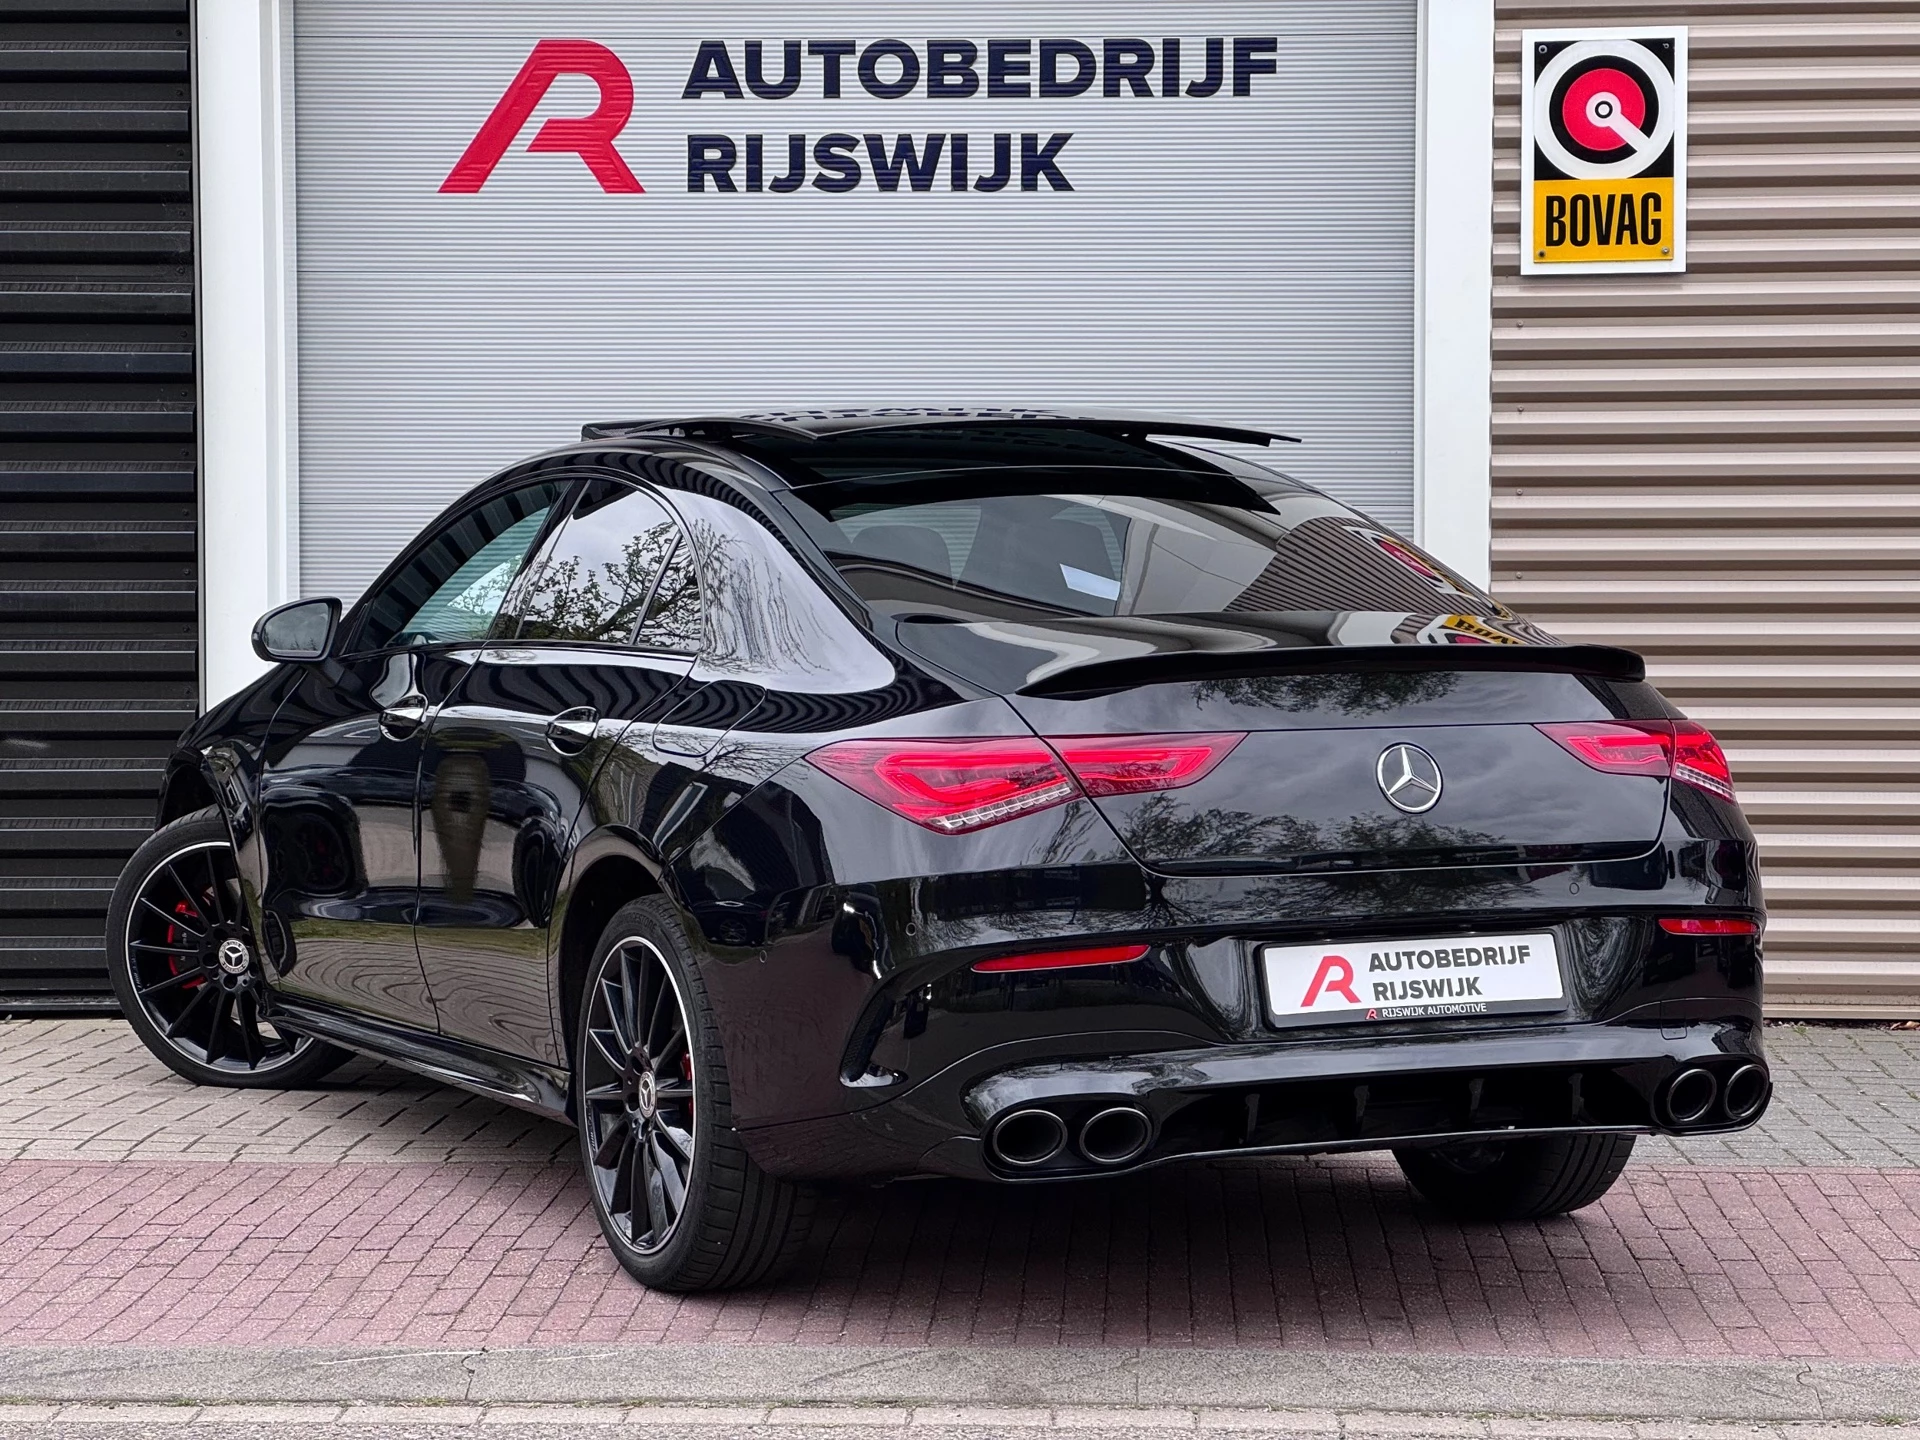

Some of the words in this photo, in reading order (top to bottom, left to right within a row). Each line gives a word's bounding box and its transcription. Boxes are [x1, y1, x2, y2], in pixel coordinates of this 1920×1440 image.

[681, 37, 1278, 99] AUTOBEDRIJF
[687, 132, 1077, 193] RIJSWIJK
[1545, 192, 1662, 247] BOVAG
[1369, 945, 1531, 972] AUTOBEDRIJF
[1372, 976, 1483, 1001] RIJSWIJK
[1381, 1006, 1426, 1018] RIJSWIJK
[1427, 1003, 1487, 1015] AUTOMOTIVE
